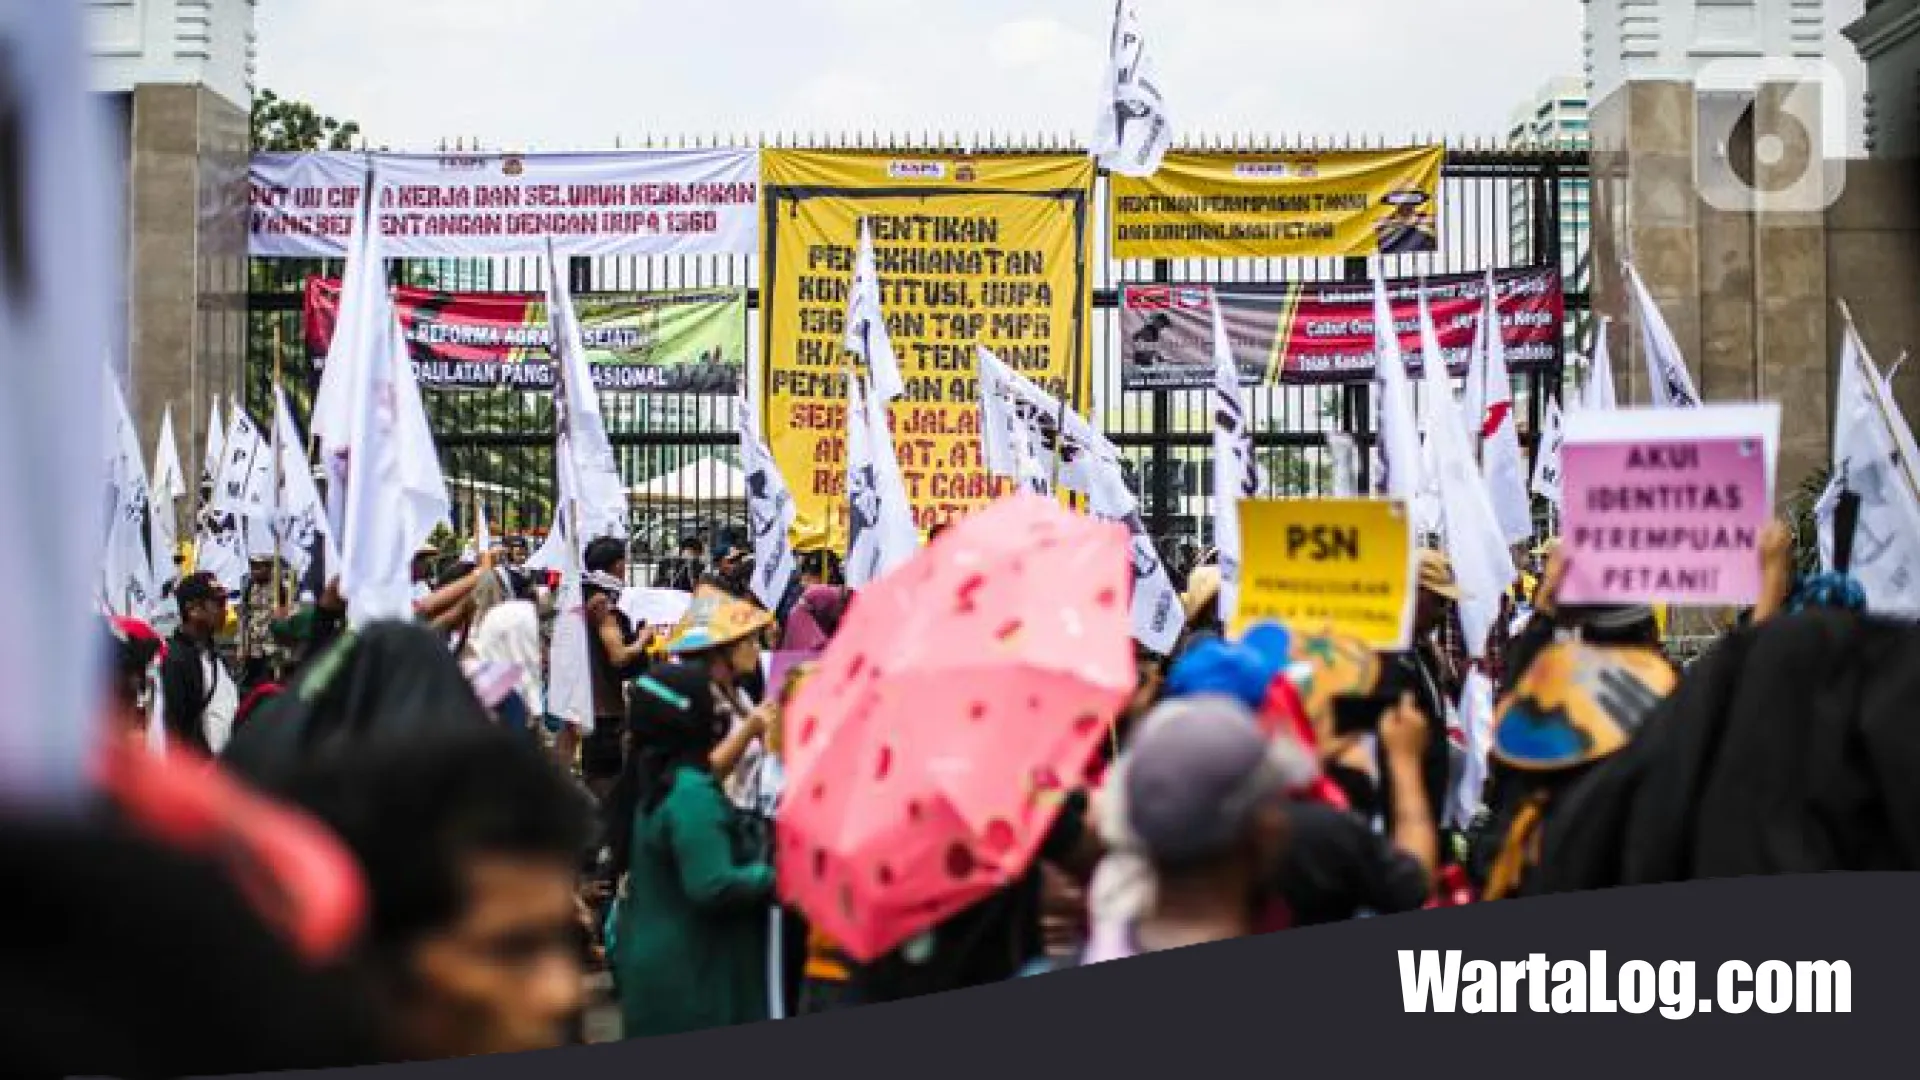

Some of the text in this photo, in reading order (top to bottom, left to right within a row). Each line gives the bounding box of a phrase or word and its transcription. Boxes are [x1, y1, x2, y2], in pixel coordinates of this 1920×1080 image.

[399, 185, 469, 208] KERJA
[475, 184, 520, 208] DAN
[525, 184, 625, 207] SELURUH
[630, 181, 757, 204] KEBIJAKAN
[507, 212, 597, 234] DENGAN
[798, 276, 974, 307] KONTITUSI,
[930, 314, 984, 339] TAP
[589, 365, 668, 386] ASIONAL
[1626, 444, 1699, 470] AKUI
[1587, 485, 1742, 512] IDENTITAS
[1286, 524, 1359, 562] PSN
[1575, 527, 1756, 551] PEREMPUAN
